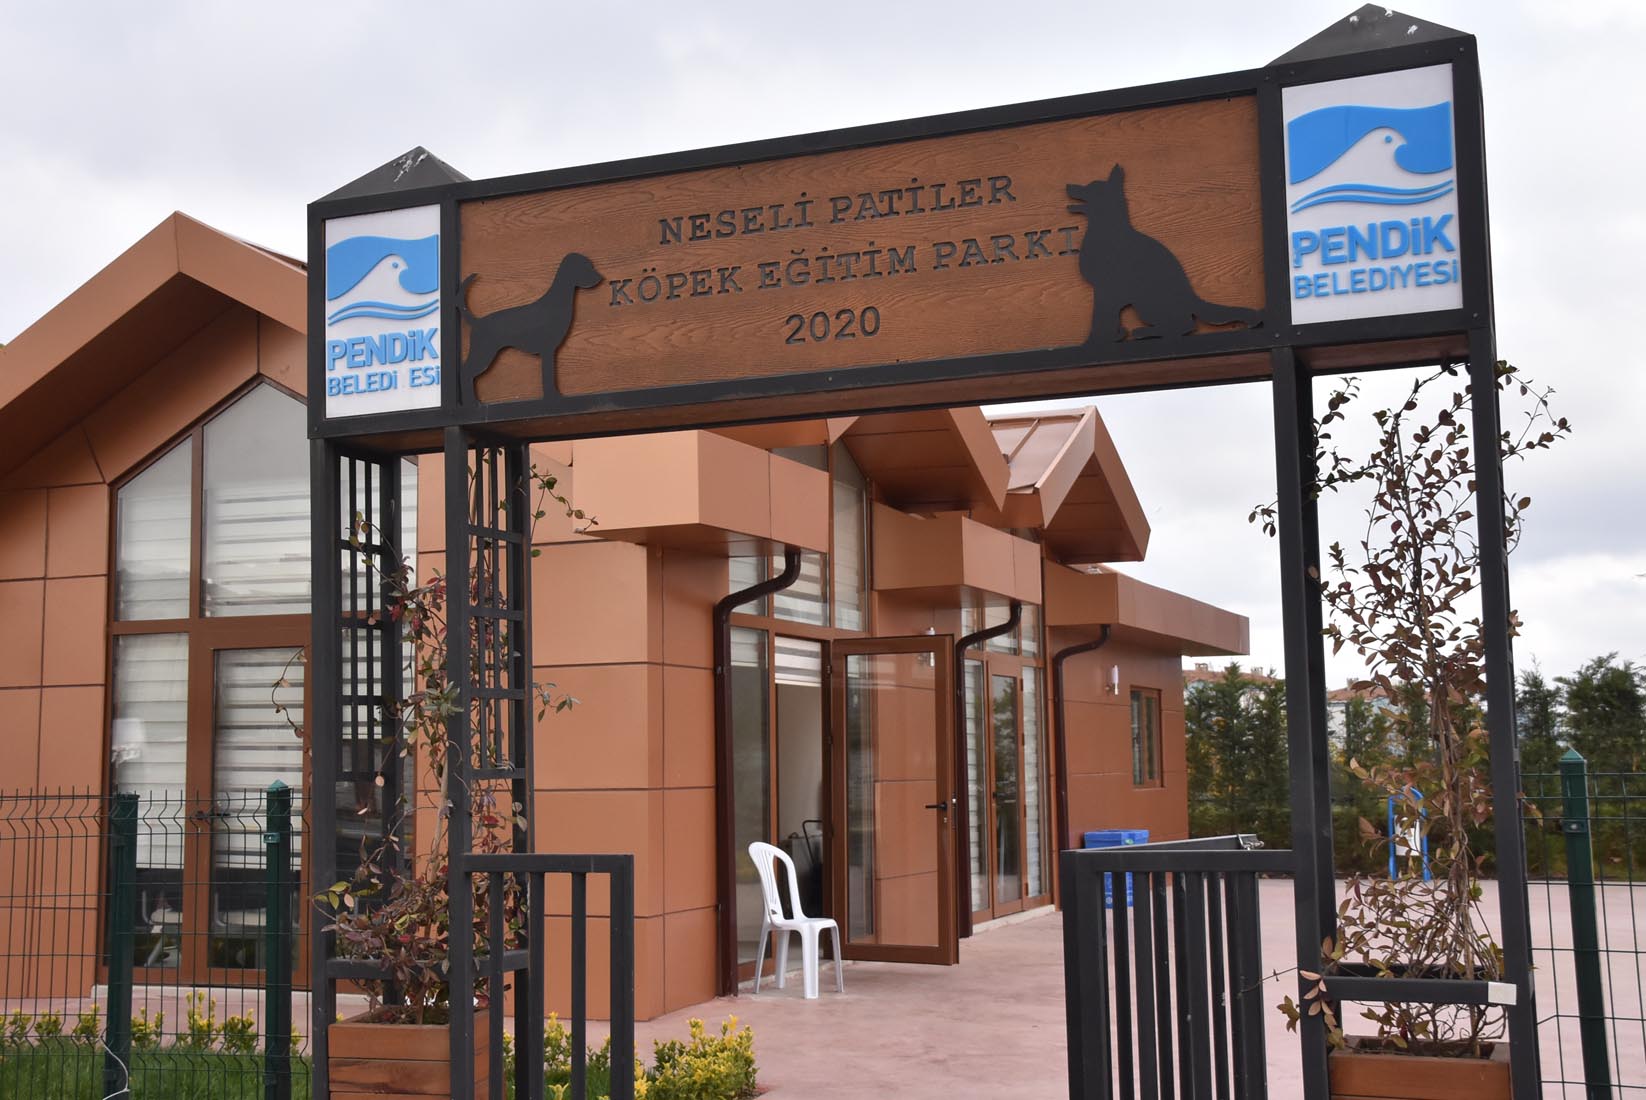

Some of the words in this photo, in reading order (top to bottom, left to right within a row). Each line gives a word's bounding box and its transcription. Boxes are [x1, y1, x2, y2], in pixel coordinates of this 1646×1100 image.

[658, 191, 815, 246] NESELİ
[829, 175, 1017, 224] PATİLER
[609, 267, 743, 307] KÖPEK
[757, 241, 917, 292] EĞİTİM
[932, 226, 1080, 271] PARKI
[785, 305, 881, 345] 2020
